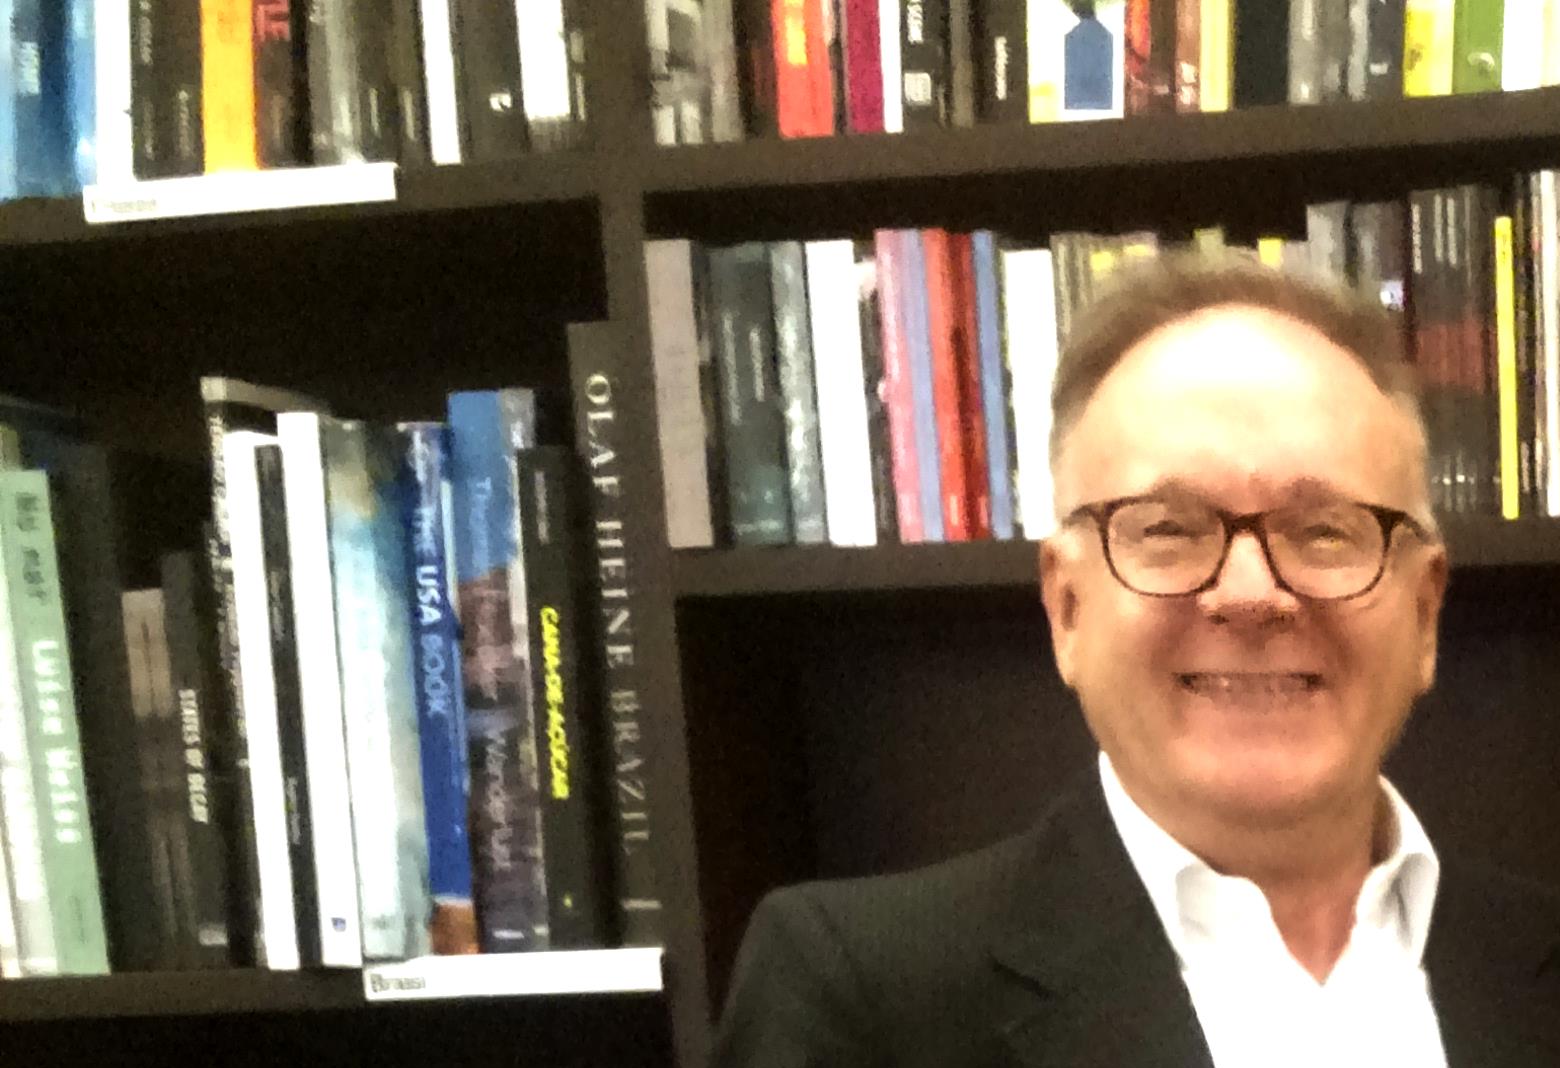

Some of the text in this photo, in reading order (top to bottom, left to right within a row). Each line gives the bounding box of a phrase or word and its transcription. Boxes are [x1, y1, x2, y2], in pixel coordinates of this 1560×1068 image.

[417, 565, 449, 626] USA
[584, 373, 652, 852] OLAF HEINE BRAZIL
[32, 641, 66, 736] Luise
[420, 632, 450, 717] BOOK
[187, 752, 204, 773] OF
